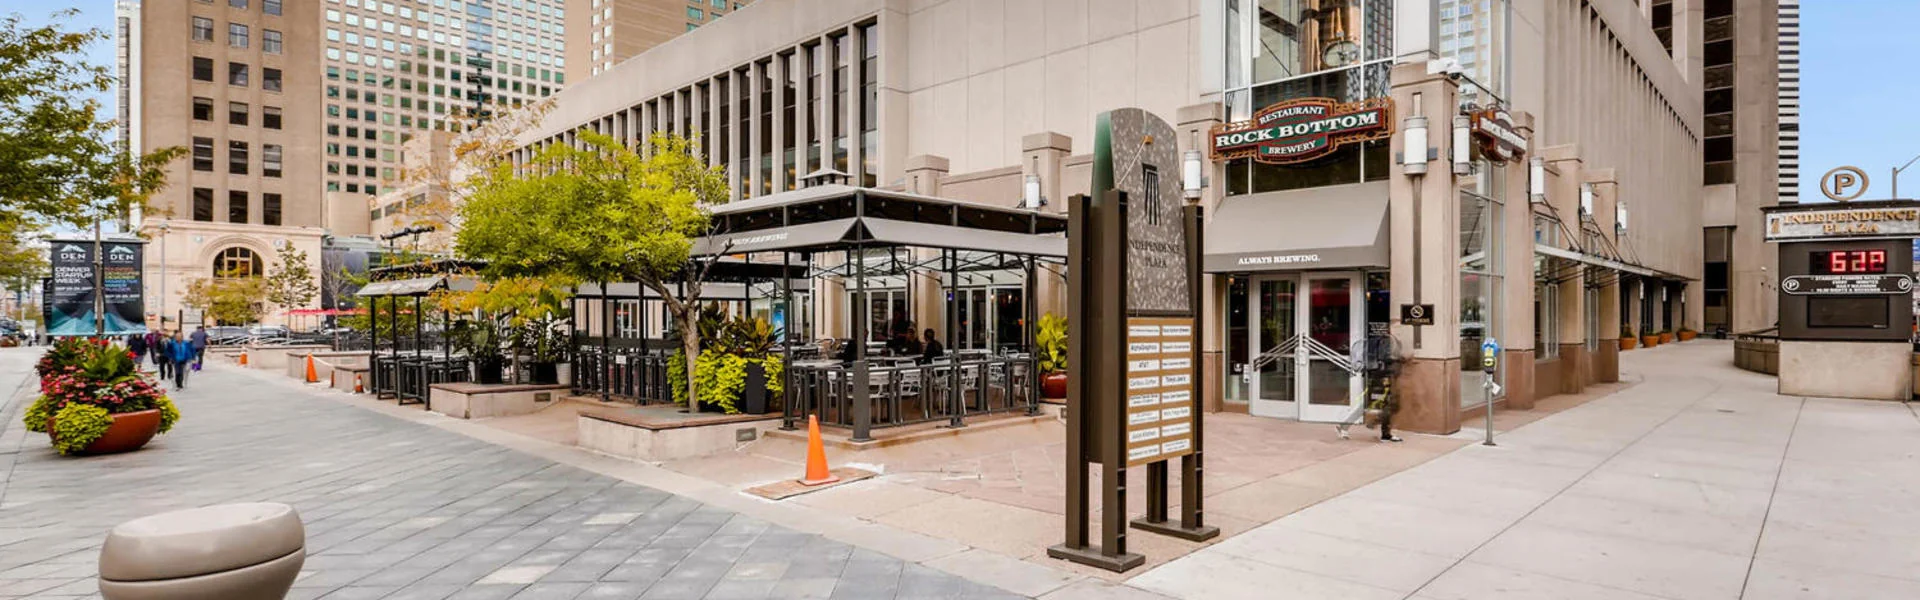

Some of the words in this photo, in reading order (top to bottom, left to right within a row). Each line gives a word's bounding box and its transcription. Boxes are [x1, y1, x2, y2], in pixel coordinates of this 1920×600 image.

[1259, 106, 1325, 125] RESTAURANT
[1215, 128, 1274, 148] ROCK
[1279, 111, 1379, 139] BOTTOM
[1268, 140, 1316, 155] BREWERY
[1834, 173, 1855, 195] P
[1783, 209, 1917, 225] INDEPENDENCE
[1823, 223, 1879, 234] PLAZA
[1238, 256, 1272, 265] ALWAYS
